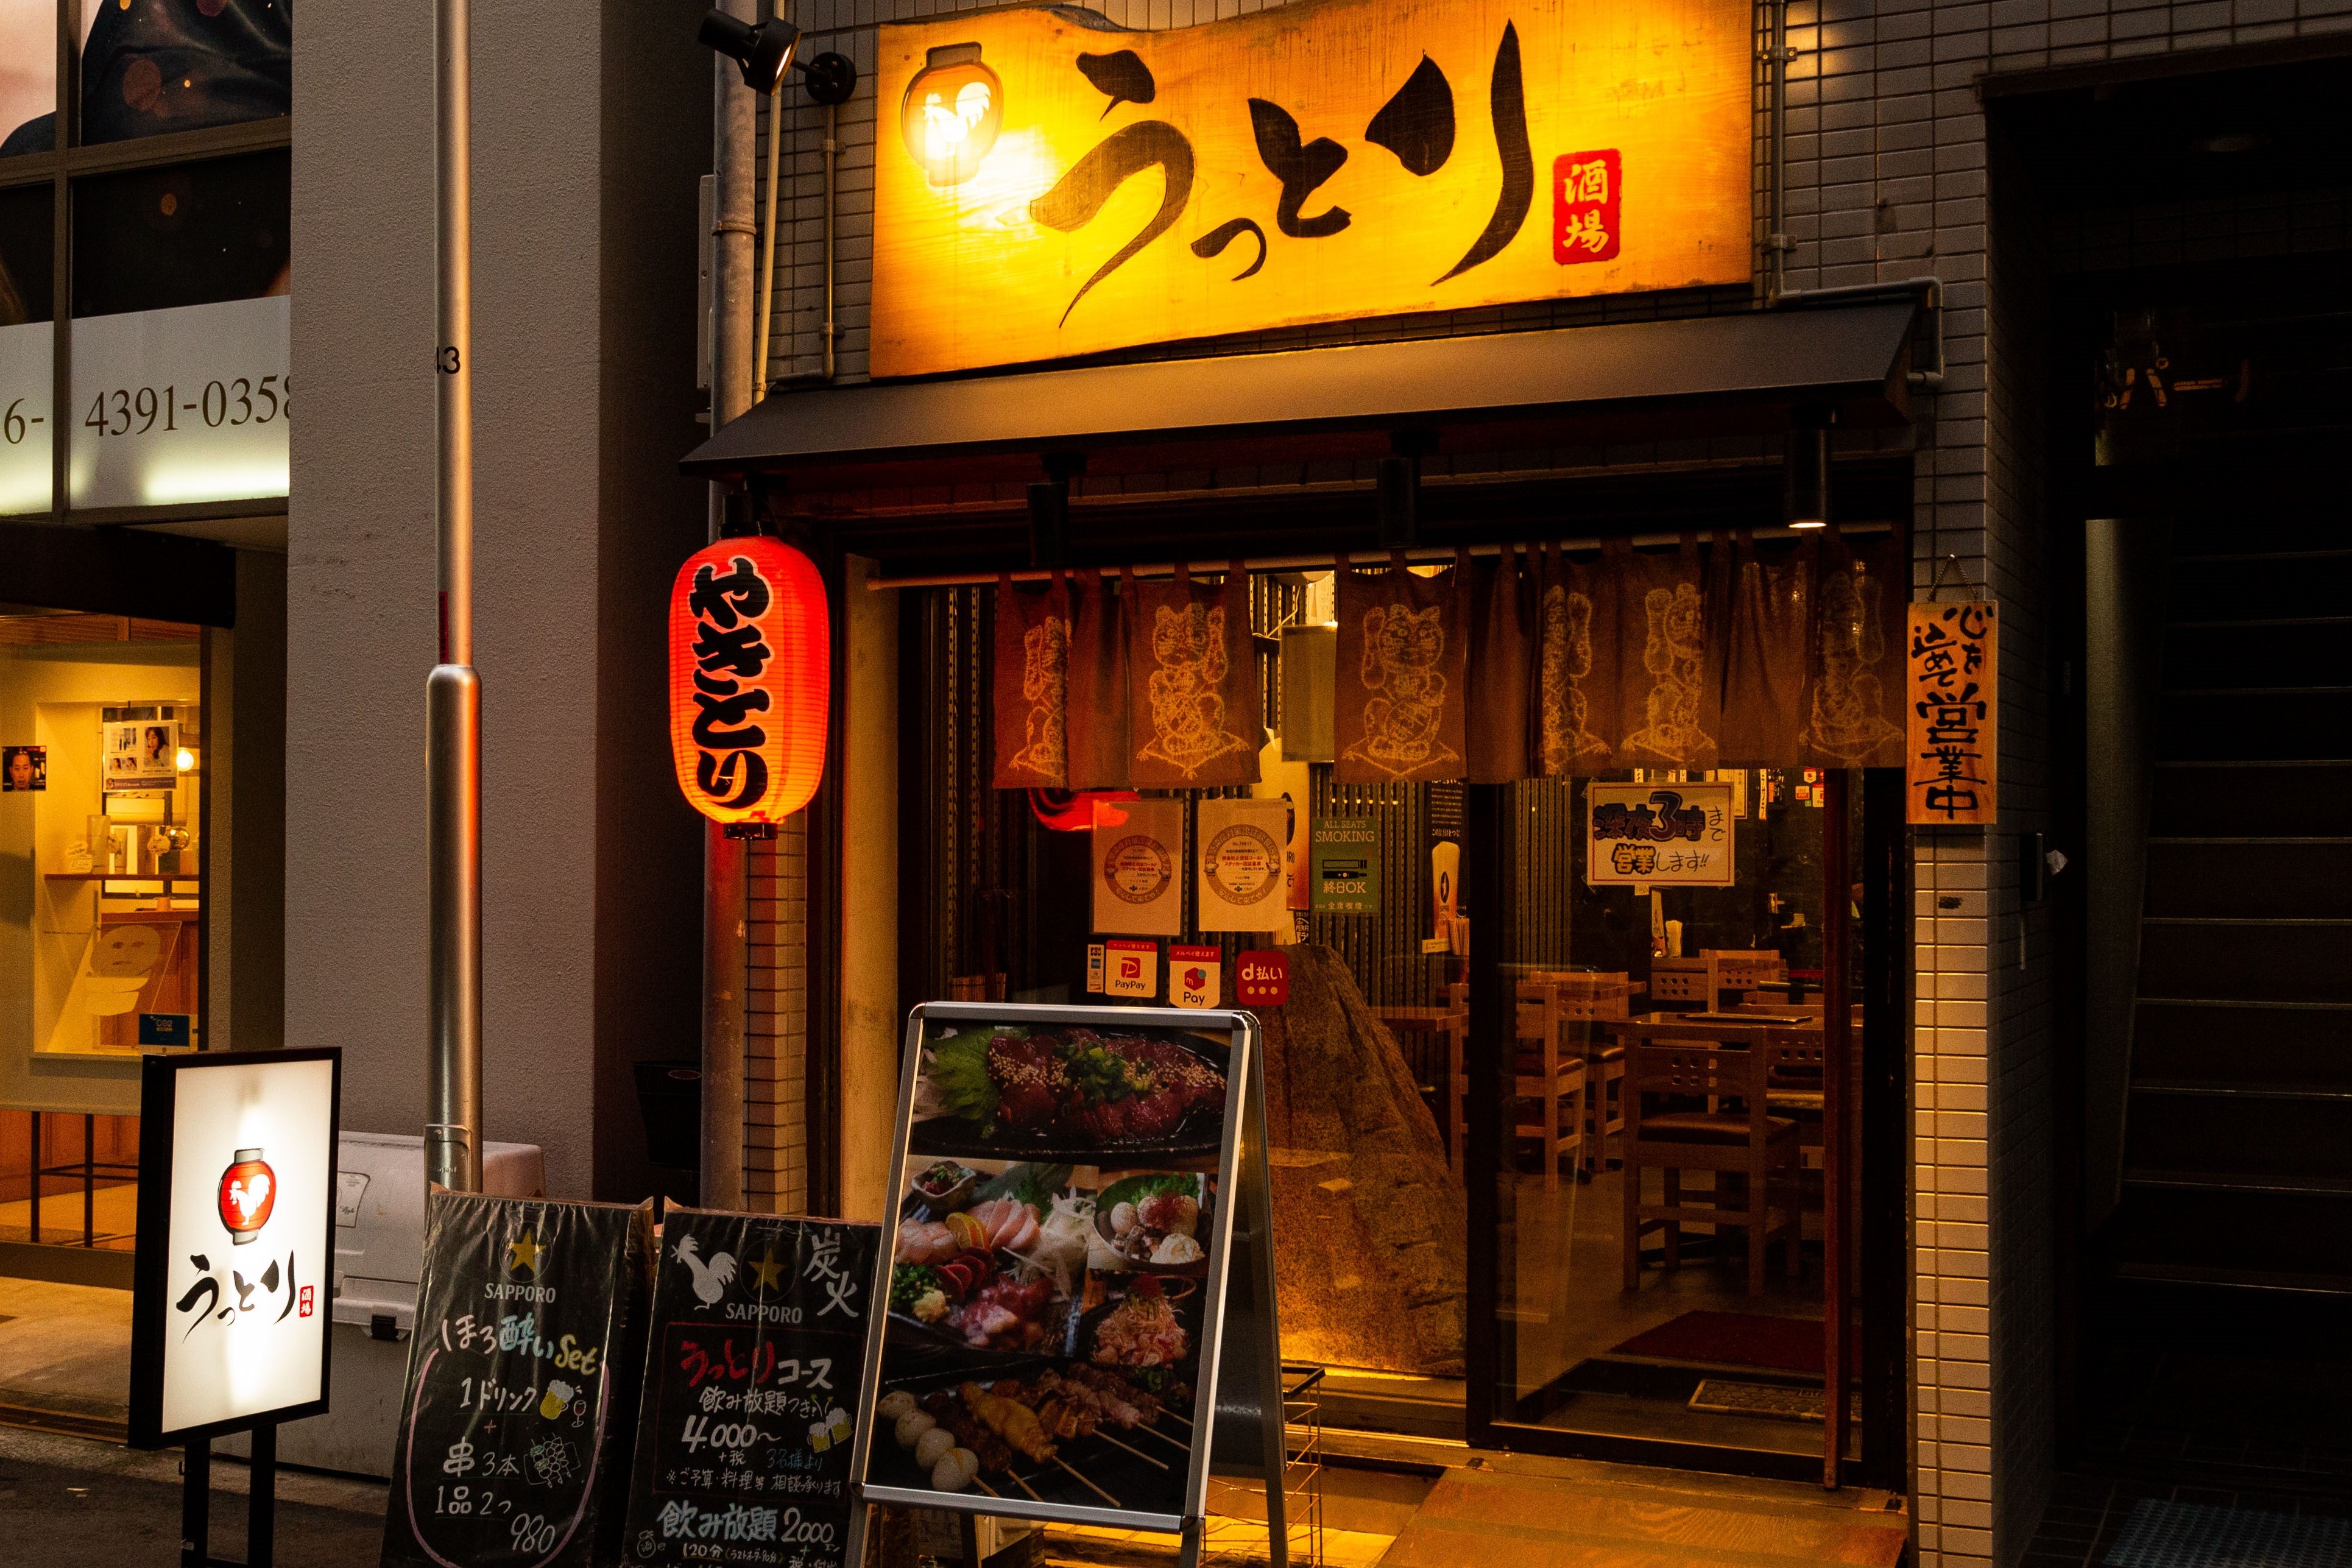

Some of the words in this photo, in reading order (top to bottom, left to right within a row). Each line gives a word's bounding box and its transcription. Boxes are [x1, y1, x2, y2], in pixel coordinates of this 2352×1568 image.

[1030, 18, 1534, 328] うっとり
[1561, 161, 1610, 255] 酒場
[689, 557, 771, 810] やきとり
[1913, 682, 1986, 820] 営業中
[1315, 830, 1375, 842] SMOKING
[1324, 820, 1339, 829] ALL
[1341, 820, 1366, 829] SEATS
[1323, 880, 1367, 894] 終日OK
[1115, 980, 1146, 991] PayPay
[1241, 963, 1283, 981] d払い
[1183, 991, 1206, 1006] Pay
[802, 1226, 860, 1318] 炭火
[175, 1249, 296, 1344] うっとり
[300, 1287, 313, 1316] 酒場
[484, 1282, 556, 1304] SAPPORO
[725, 1302, 802, 1324] SAPPORO
[510, 1512, 556, 1554] 980
[655, 1499, 779, 1542] 飲み放題
